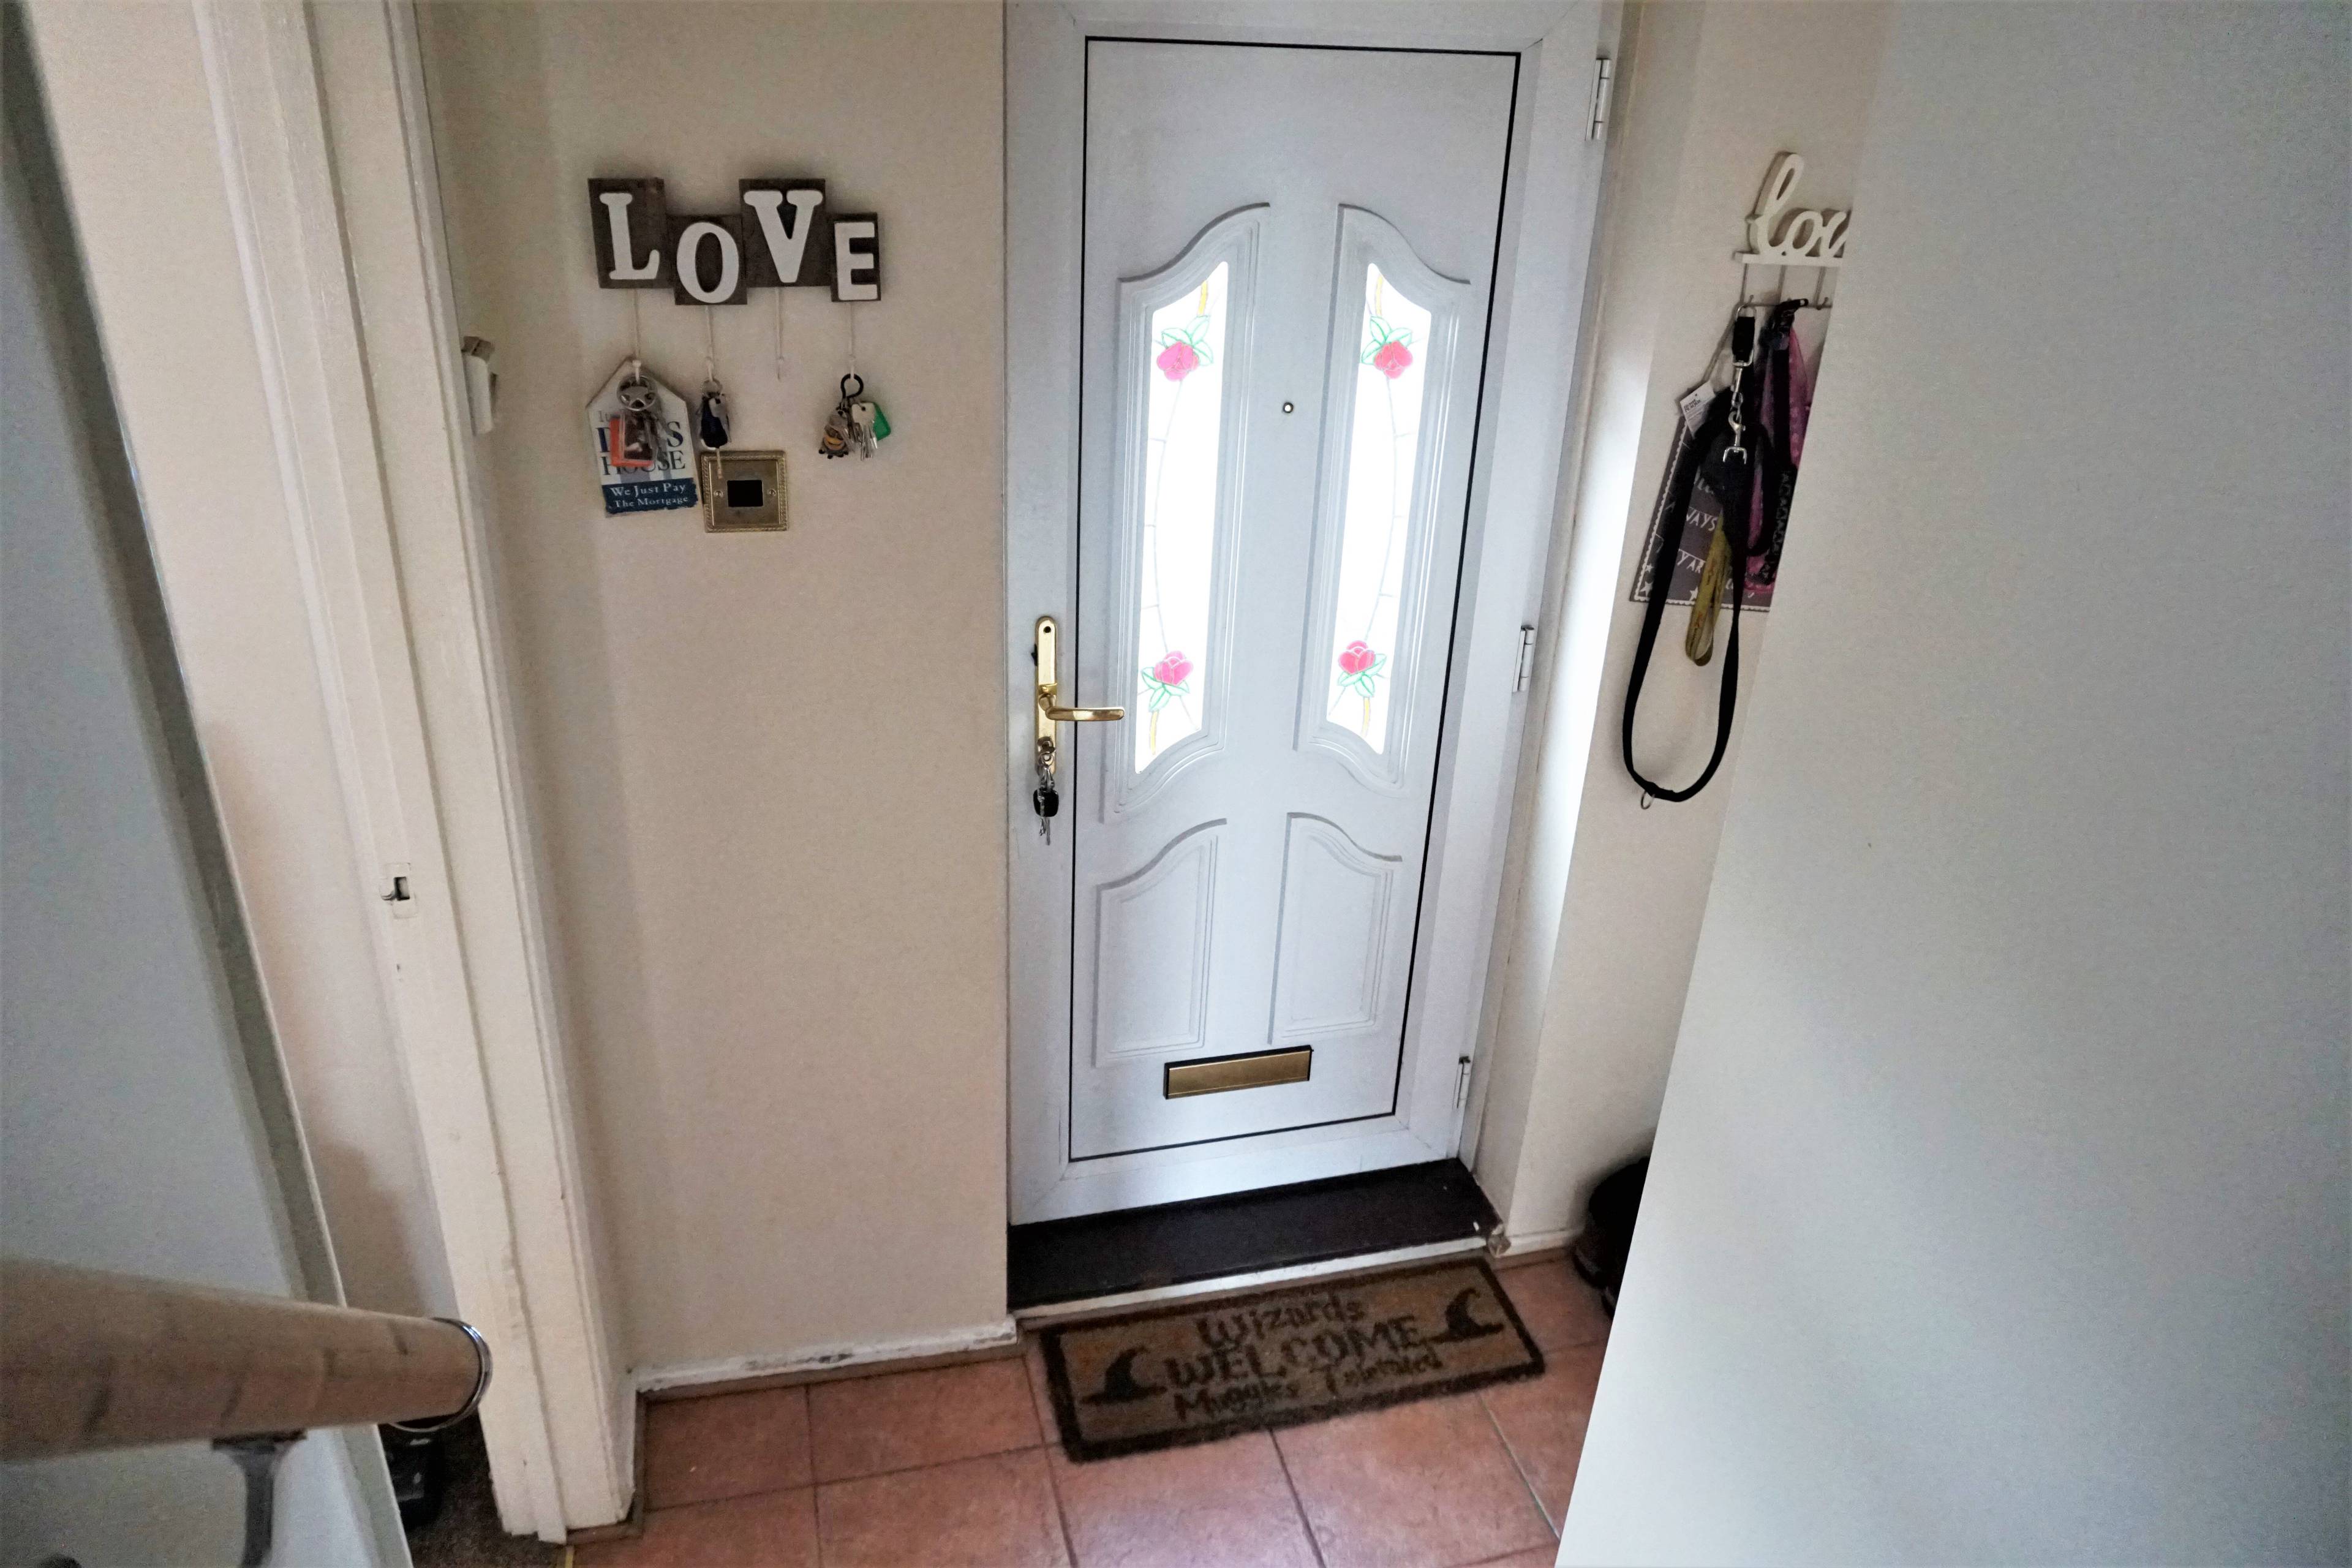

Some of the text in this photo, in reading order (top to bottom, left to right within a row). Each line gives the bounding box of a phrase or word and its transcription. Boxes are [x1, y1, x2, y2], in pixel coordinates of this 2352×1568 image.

[599, 190, 878, 303] LOVE
[610, 483, 687, 498] We Just Pay
[614, 497, 688, 508] The Mortgage
[1164, 1315, 1420, 1387] WELCOME
